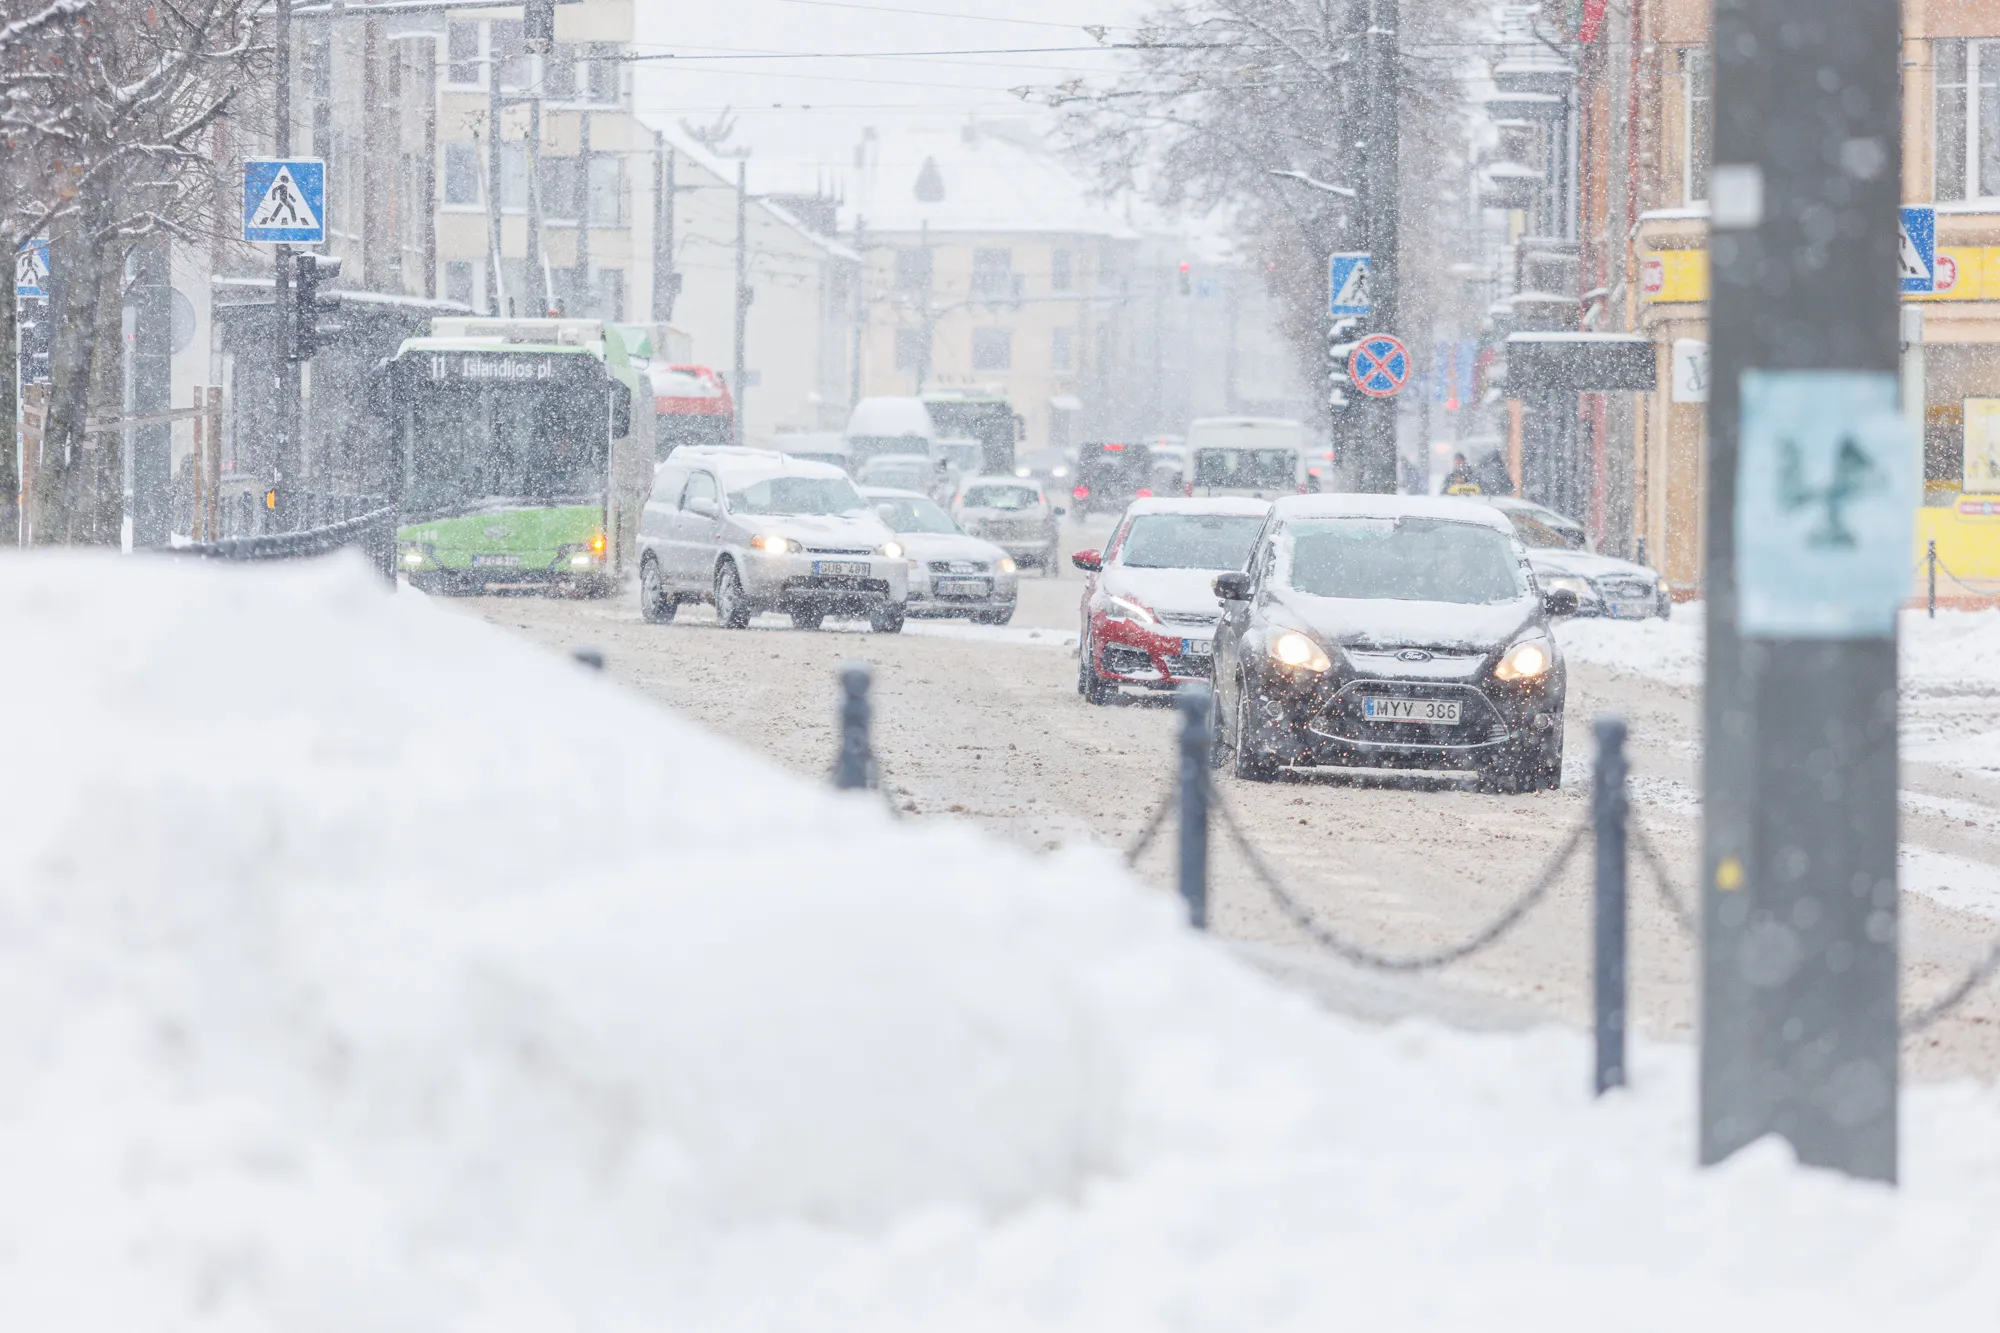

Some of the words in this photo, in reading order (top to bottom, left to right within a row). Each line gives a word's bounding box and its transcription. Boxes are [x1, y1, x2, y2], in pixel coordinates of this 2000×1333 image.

[430, 355, 446, 379] 11
[1404, 651, 1424, 660] Ford
[1376, 701, 1414, 716] MYV
[1425, 703, 1457, 719] 386
